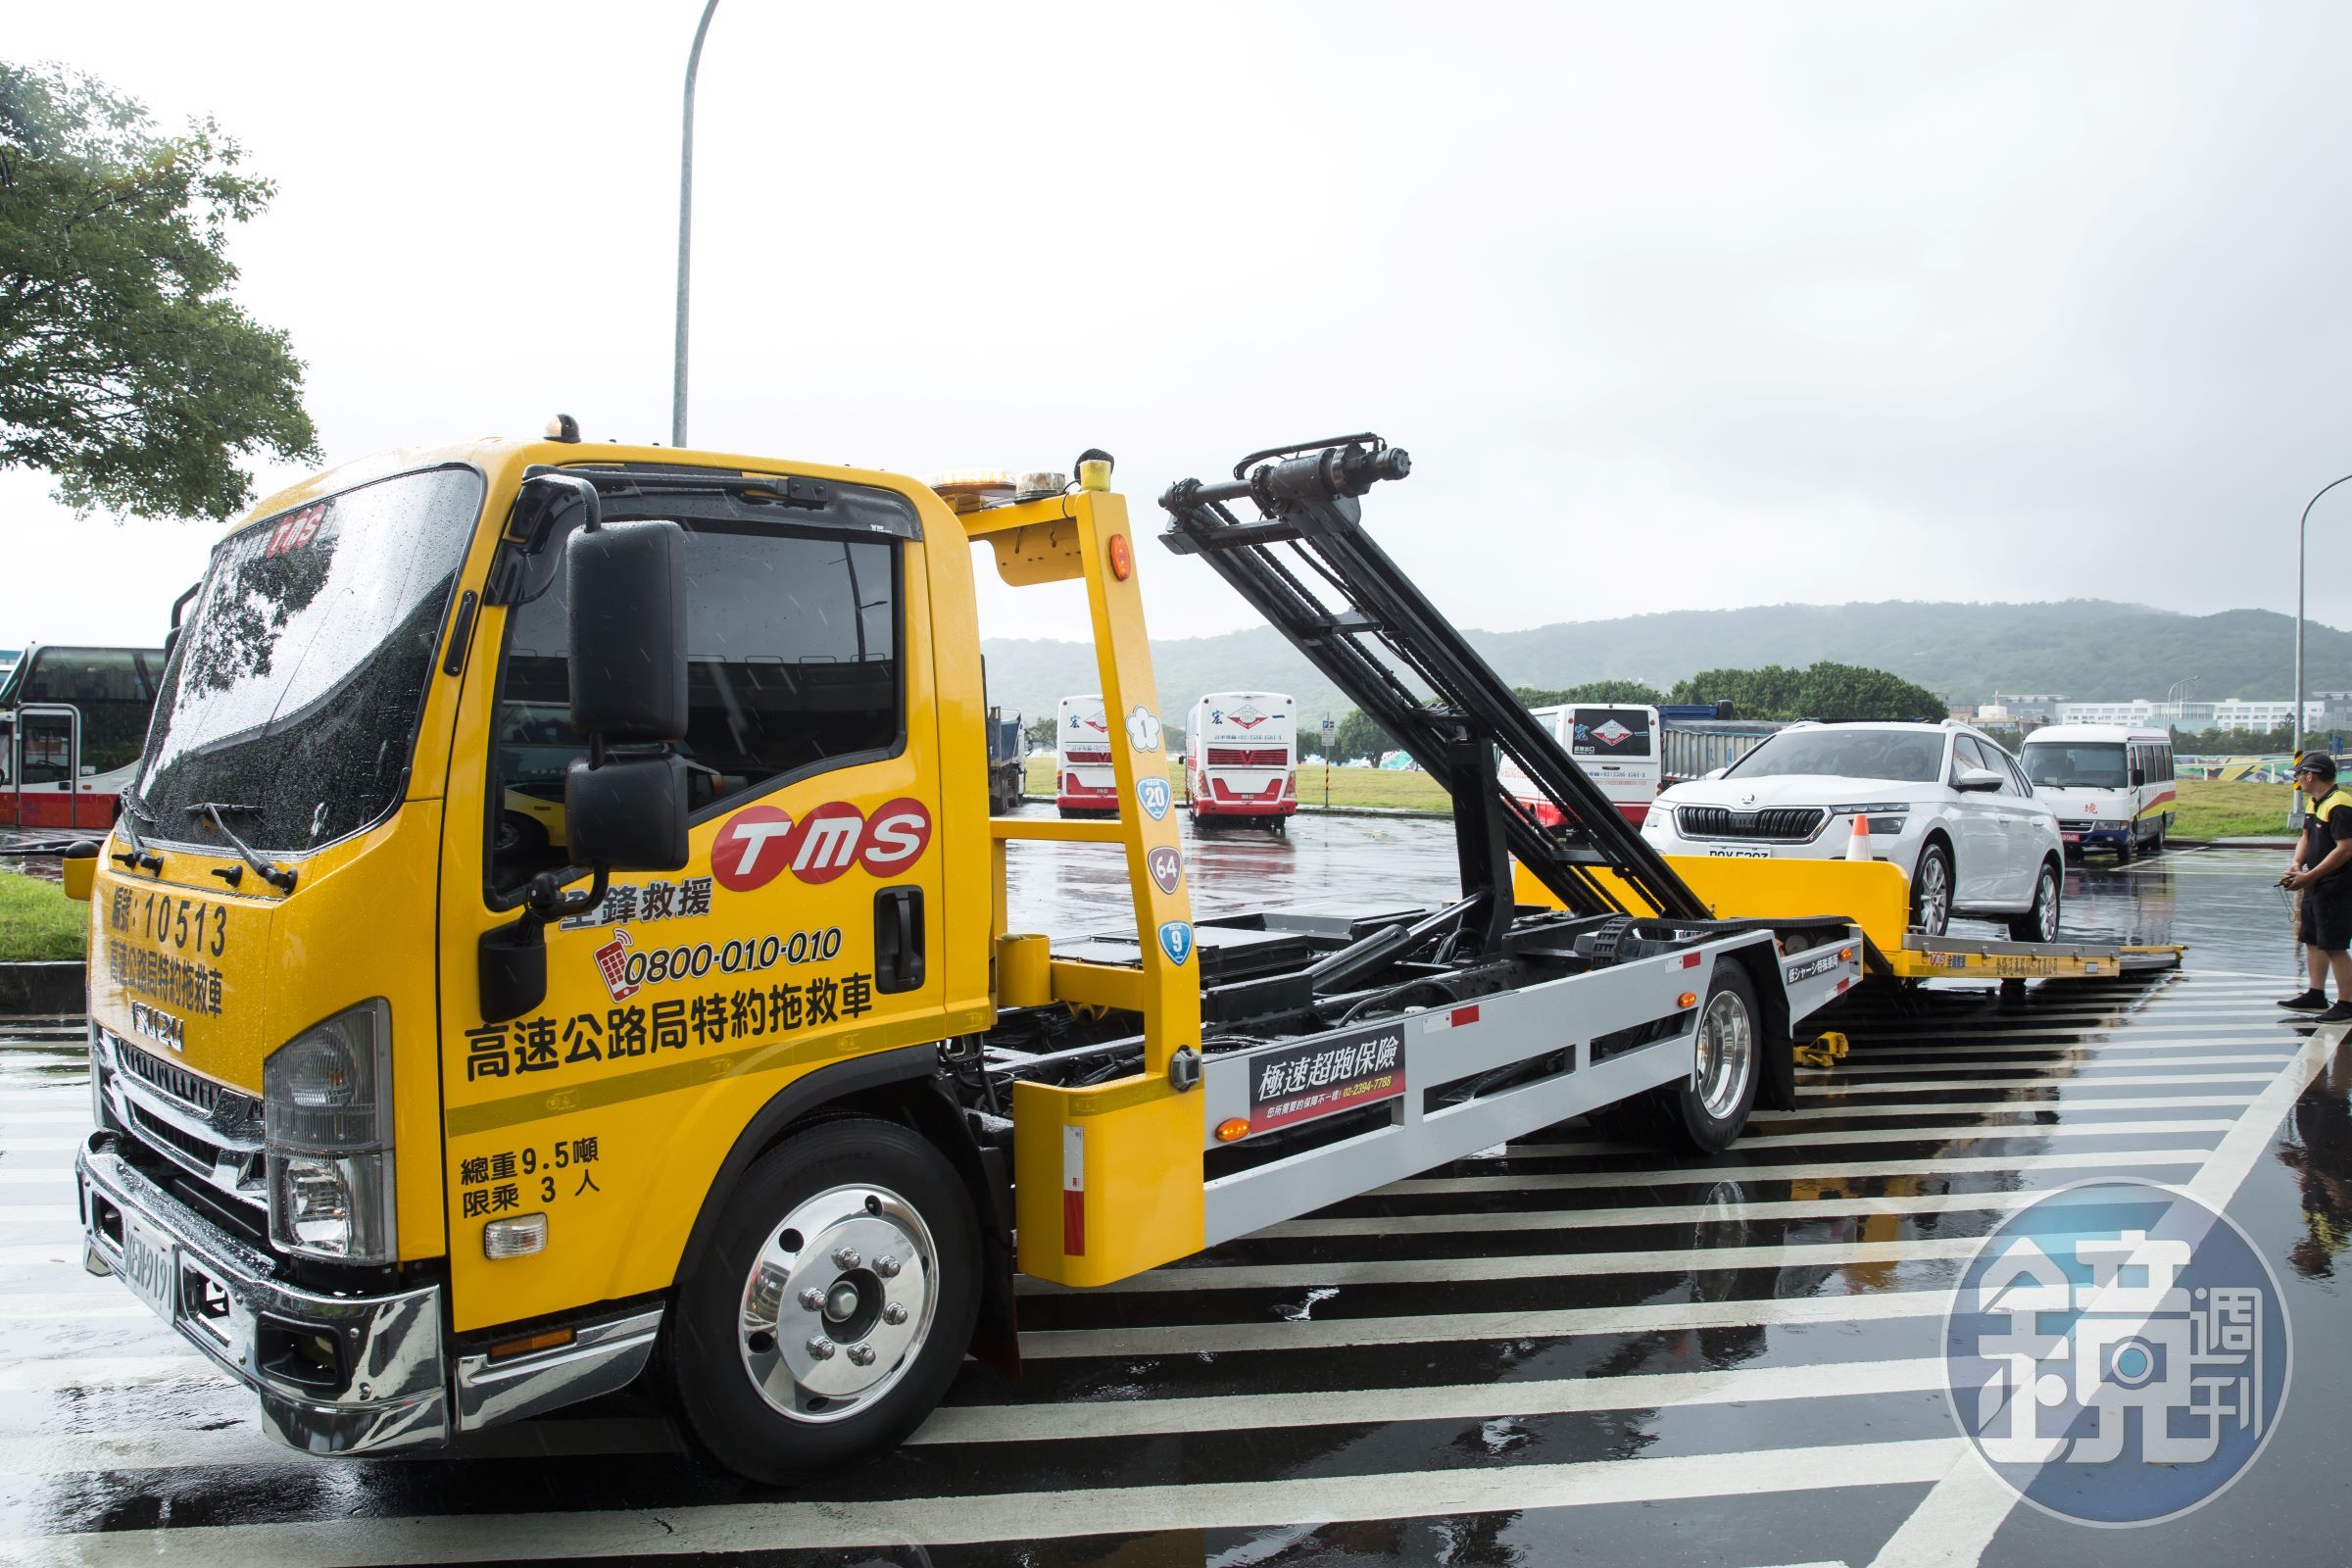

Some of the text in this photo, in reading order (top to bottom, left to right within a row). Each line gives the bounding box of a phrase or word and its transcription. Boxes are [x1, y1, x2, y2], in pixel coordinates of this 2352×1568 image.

[271, 513, 323, 554] TMS
[1146, 787, 1165, 807] 20
[727, 811, 926, 876] TMS
[1155, 856, 1178, 880] 64
[623, 926, 843, 986] 0800-010-010
[1171, 930, 1183, 953] 9
[110, 940, 223, 1019] 高速公路局特約拖救車
[130, 1000, 185, 1053] ISUZU
[464, 971, 873, 1083] 高速公路局特約拖救車
[1257, 1034, 1399, 1102] 極速超跑保險
[1343, 1075, 1393, 1099] 02-2394-7788
[461, 1136, 599, 1187] 總重9.5噸
